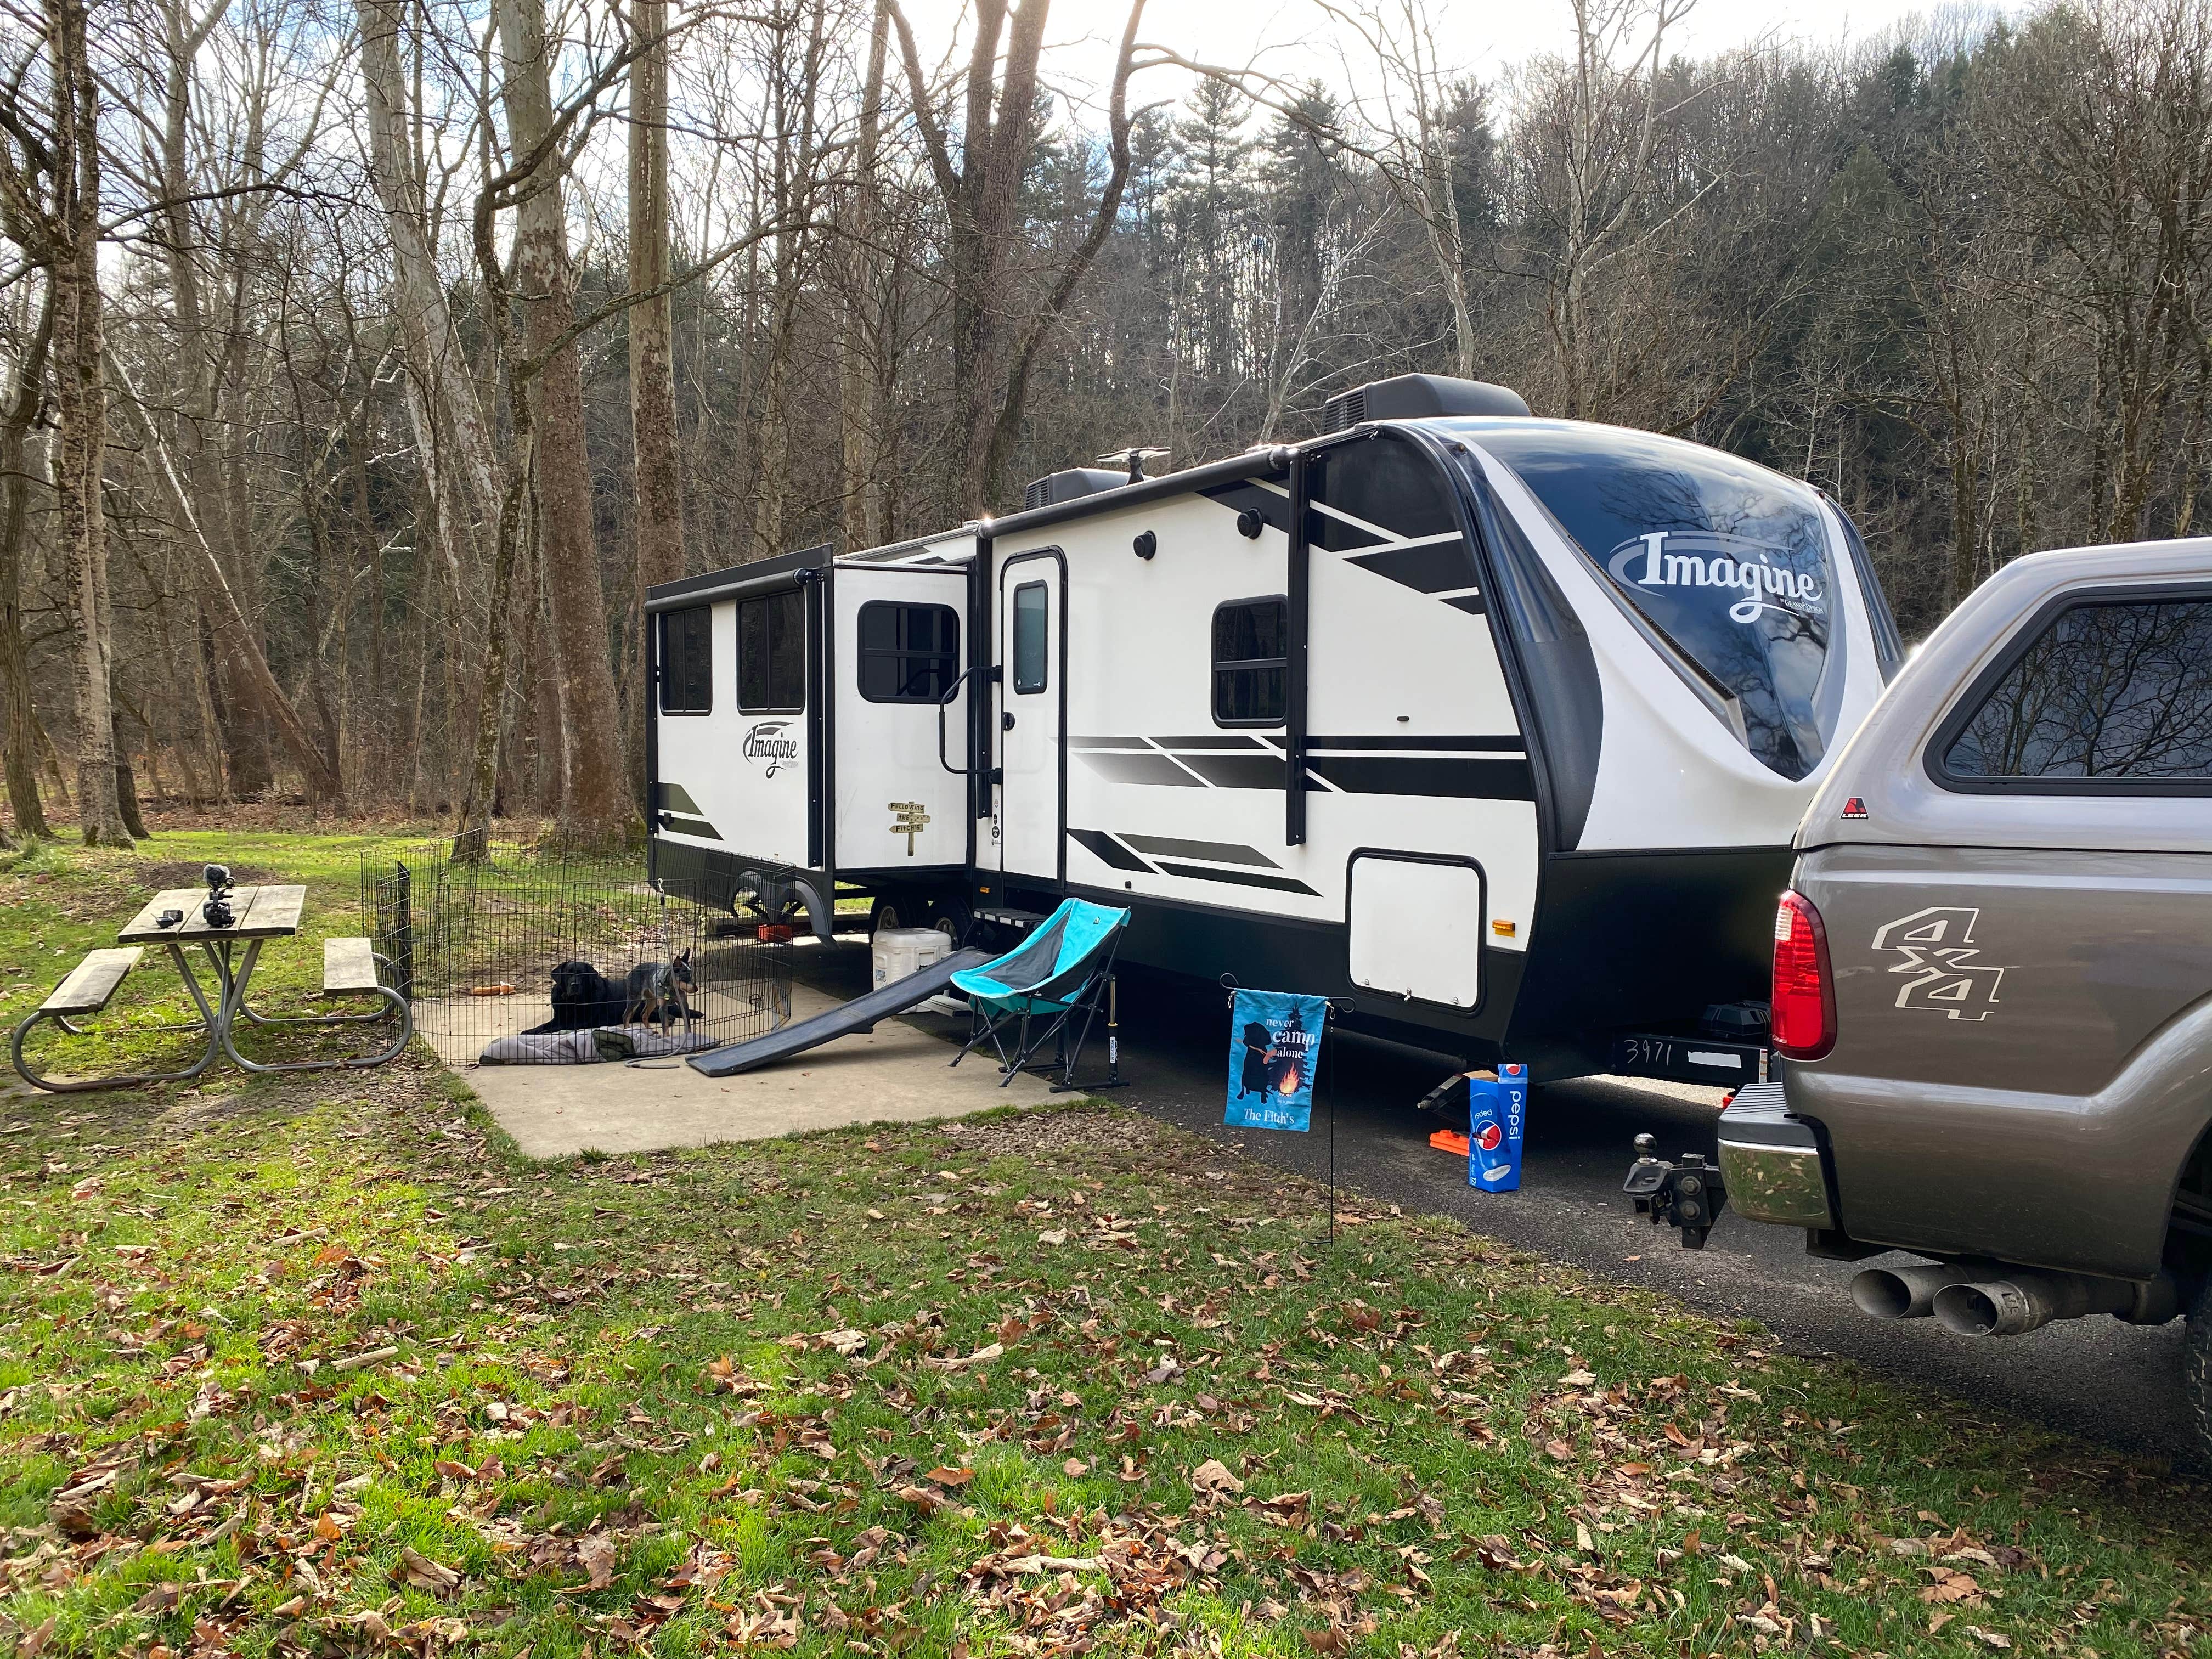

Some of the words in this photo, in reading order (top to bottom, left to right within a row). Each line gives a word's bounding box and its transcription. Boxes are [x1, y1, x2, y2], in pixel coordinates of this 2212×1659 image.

[1638, 531, 1822, 624] Imagine
[747, 724, 798, 779] Imagine
[1266, 1018, 1294, 1028] never
[1272, 1031, 1315, 1051] camp
[1277, 1046, 1304, 1059] alone
[1623, 1040, 1672, 1066] 3971
[1244, 1108, 1261, 1121] The
[1264, 1109, 1295, 1124] Fitch's
[1474, 1108, 1493, 1121] pepsi
[1508, 1091, 1521, 1140] pepsi
